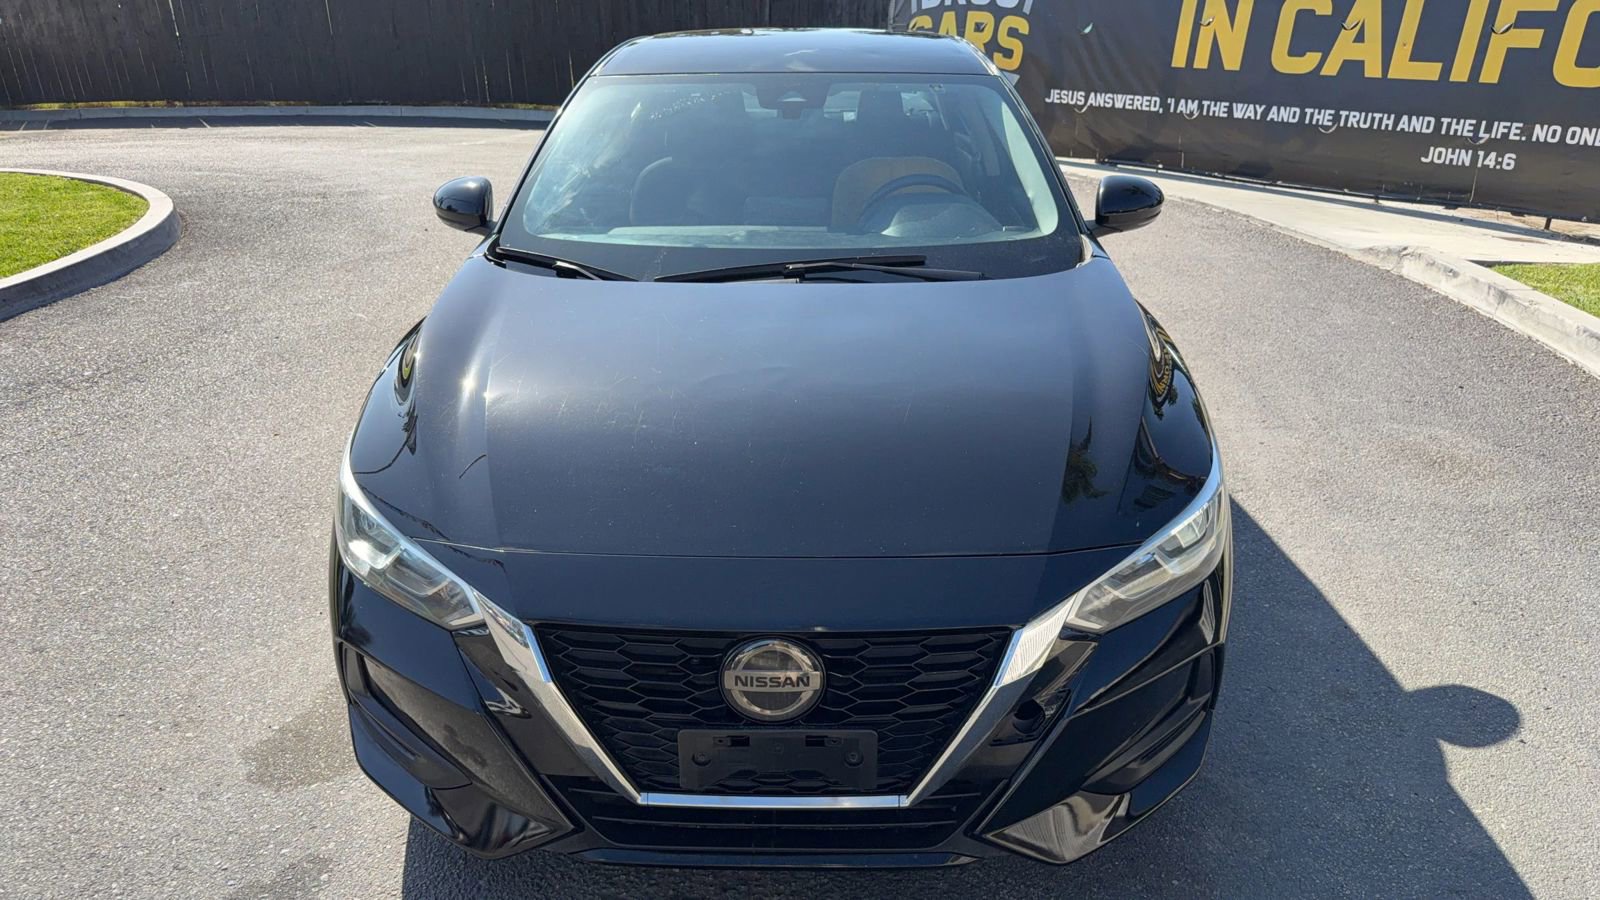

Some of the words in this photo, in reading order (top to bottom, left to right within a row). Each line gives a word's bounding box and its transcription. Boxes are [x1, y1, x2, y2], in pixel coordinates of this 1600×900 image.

[1171, 0, 1252, 71] IN
[1045, 89, 1085, 106] JESUS
[1087, 92, 1163, 114] ANSWERED,
[1177, 99, 1198, 115] AM
[1202, 101, 1229, 118] THE
[1232, 103, 1265, 120] WAY
[1266, 106, 1300, 124] AND
[1304, 108, 1335, 126] THE
[1339, 111, 1395, 131] TRUTH
[1396, 115, 1435, 134] AND
[1440, 117, 1476, 137] THE
[1478, 120, 1526, 141] LIFE.
[1531, 124, 1562, 144] NO
[1420, 146, 1472, 167] JOHN
[1477, 150, 1517, 171] 14:6
[734, 675, 810, 688] NISSAN
